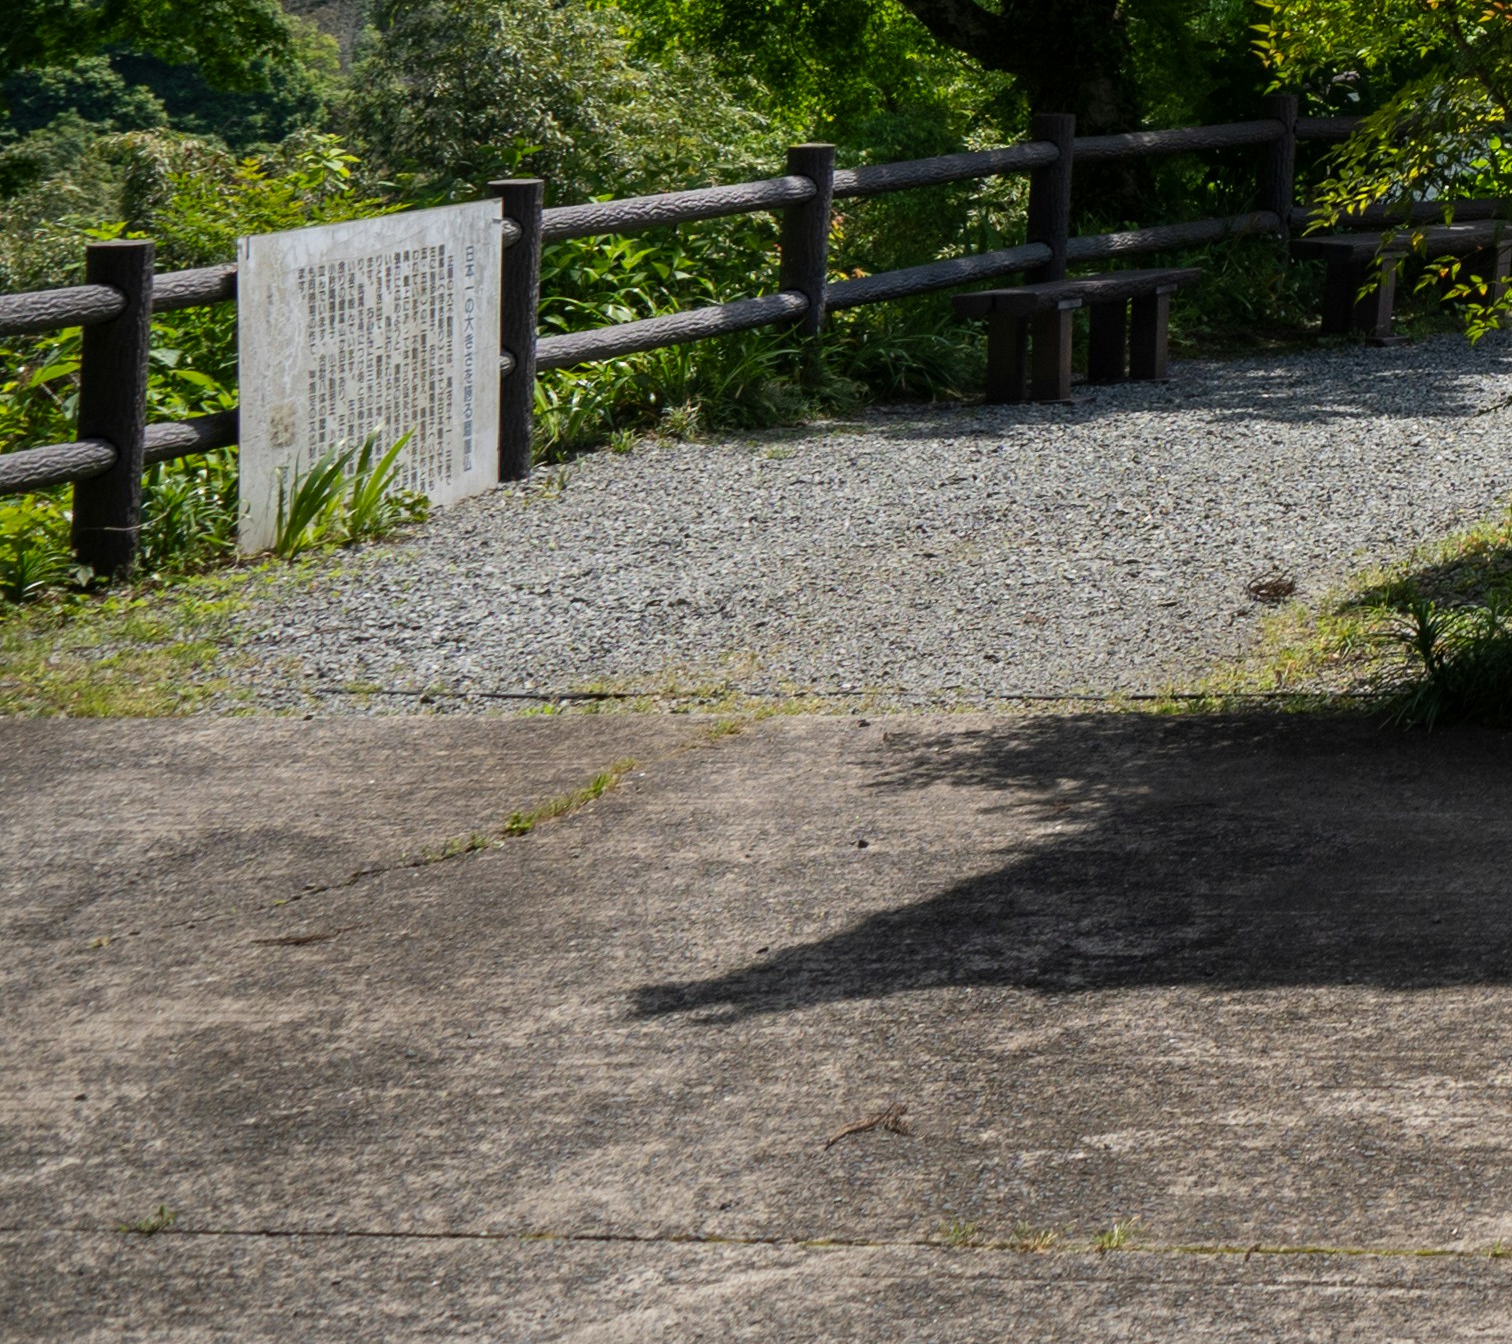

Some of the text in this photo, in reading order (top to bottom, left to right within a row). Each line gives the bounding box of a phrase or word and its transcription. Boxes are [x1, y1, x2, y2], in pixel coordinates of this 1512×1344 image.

[462, 244, 474, 473] 日本一の大きさを誇る磨崖仏
